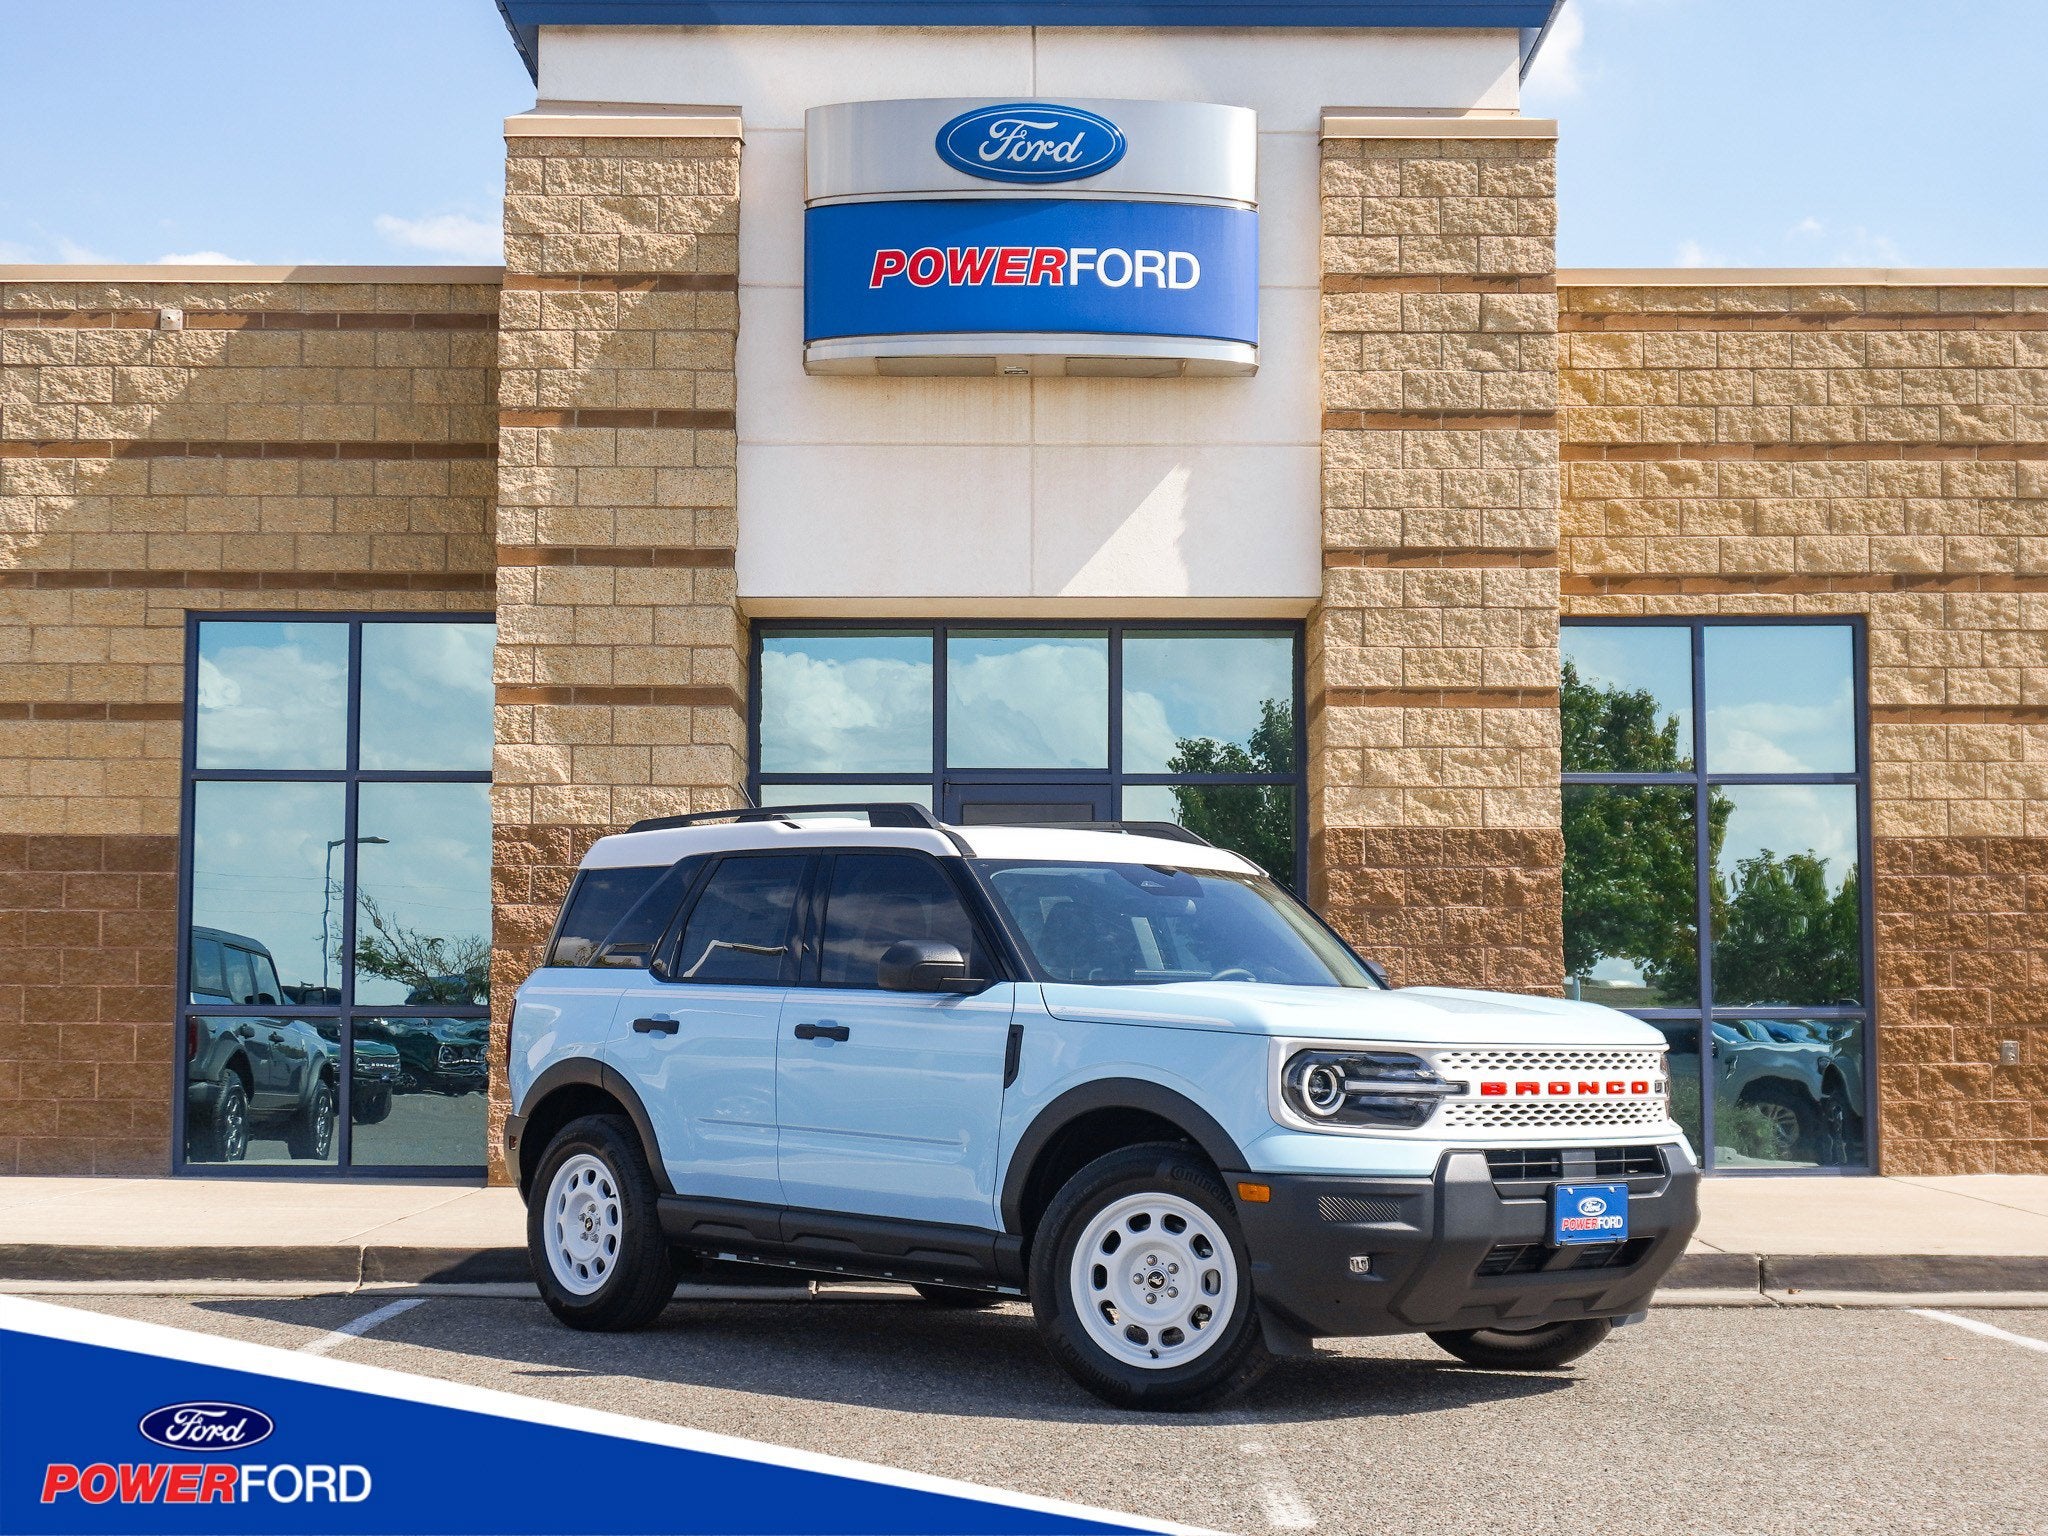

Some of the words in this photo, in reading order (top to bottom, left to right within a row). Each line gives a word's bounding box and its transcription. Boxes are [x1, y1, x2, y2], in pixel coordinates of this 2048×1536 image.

[978, 119, 1085, 163] Ford
[869, 246, 1201, 290] POWERFORD
[1480, 1081, 1649, 1096] BRONCO
